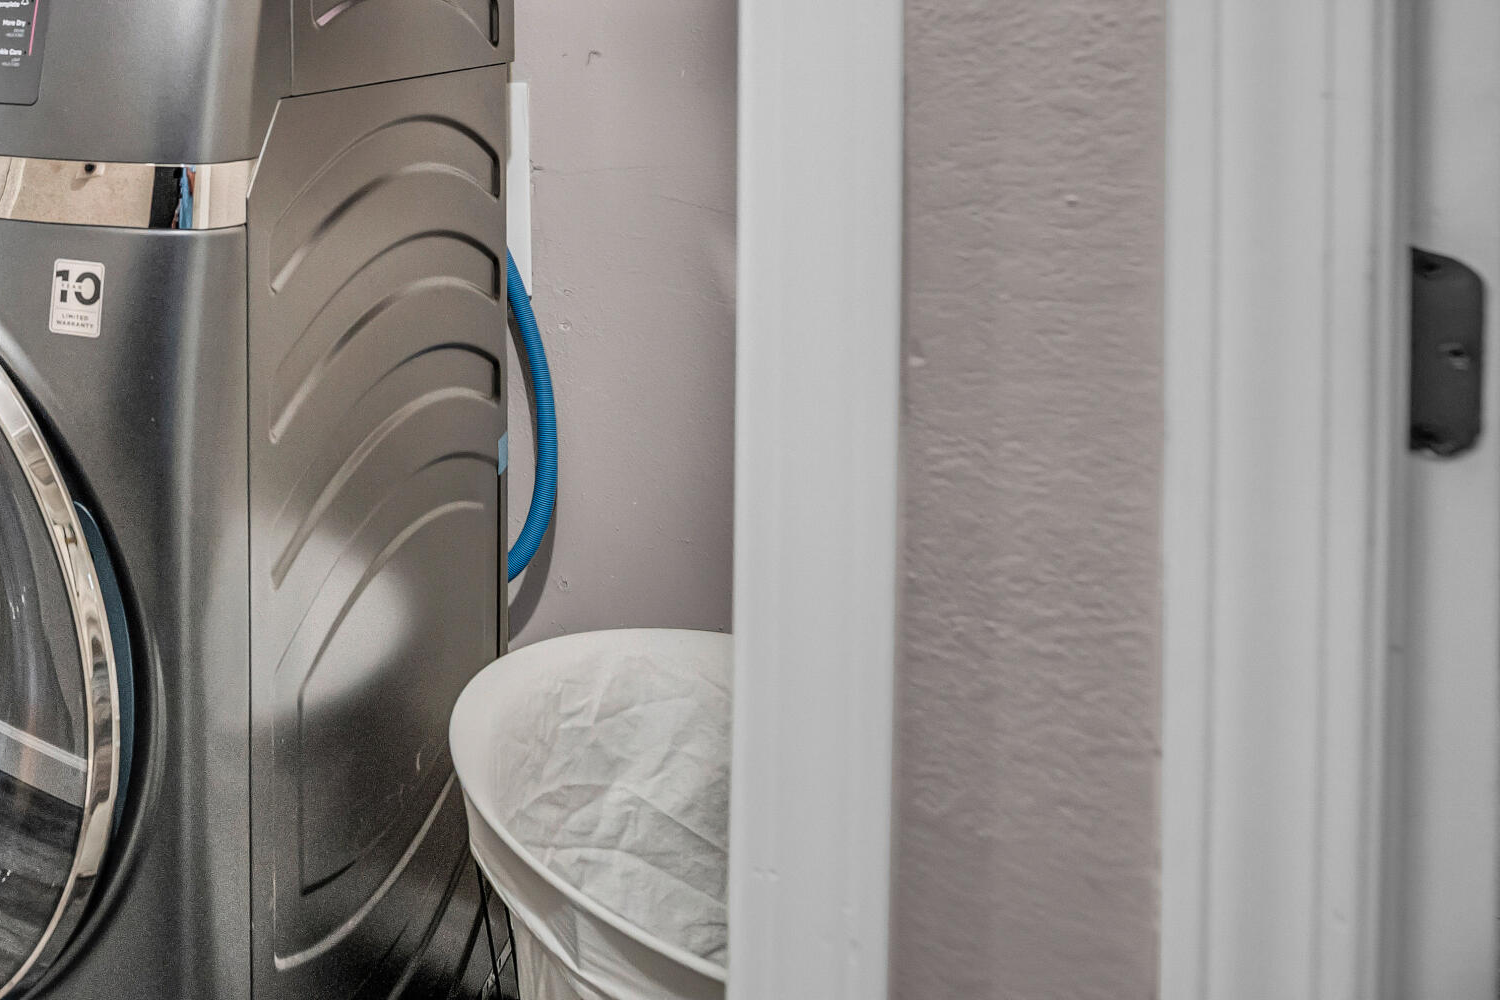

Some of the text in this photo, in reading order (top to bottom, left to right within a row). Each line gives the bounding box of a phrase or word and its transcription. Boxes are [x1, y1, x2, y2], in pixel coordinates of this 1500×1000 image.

[56, 269, 101, 306] 10
[61, 313, 90, 321] LIMITED
[56, 320, 94, 329] WARRANTY
